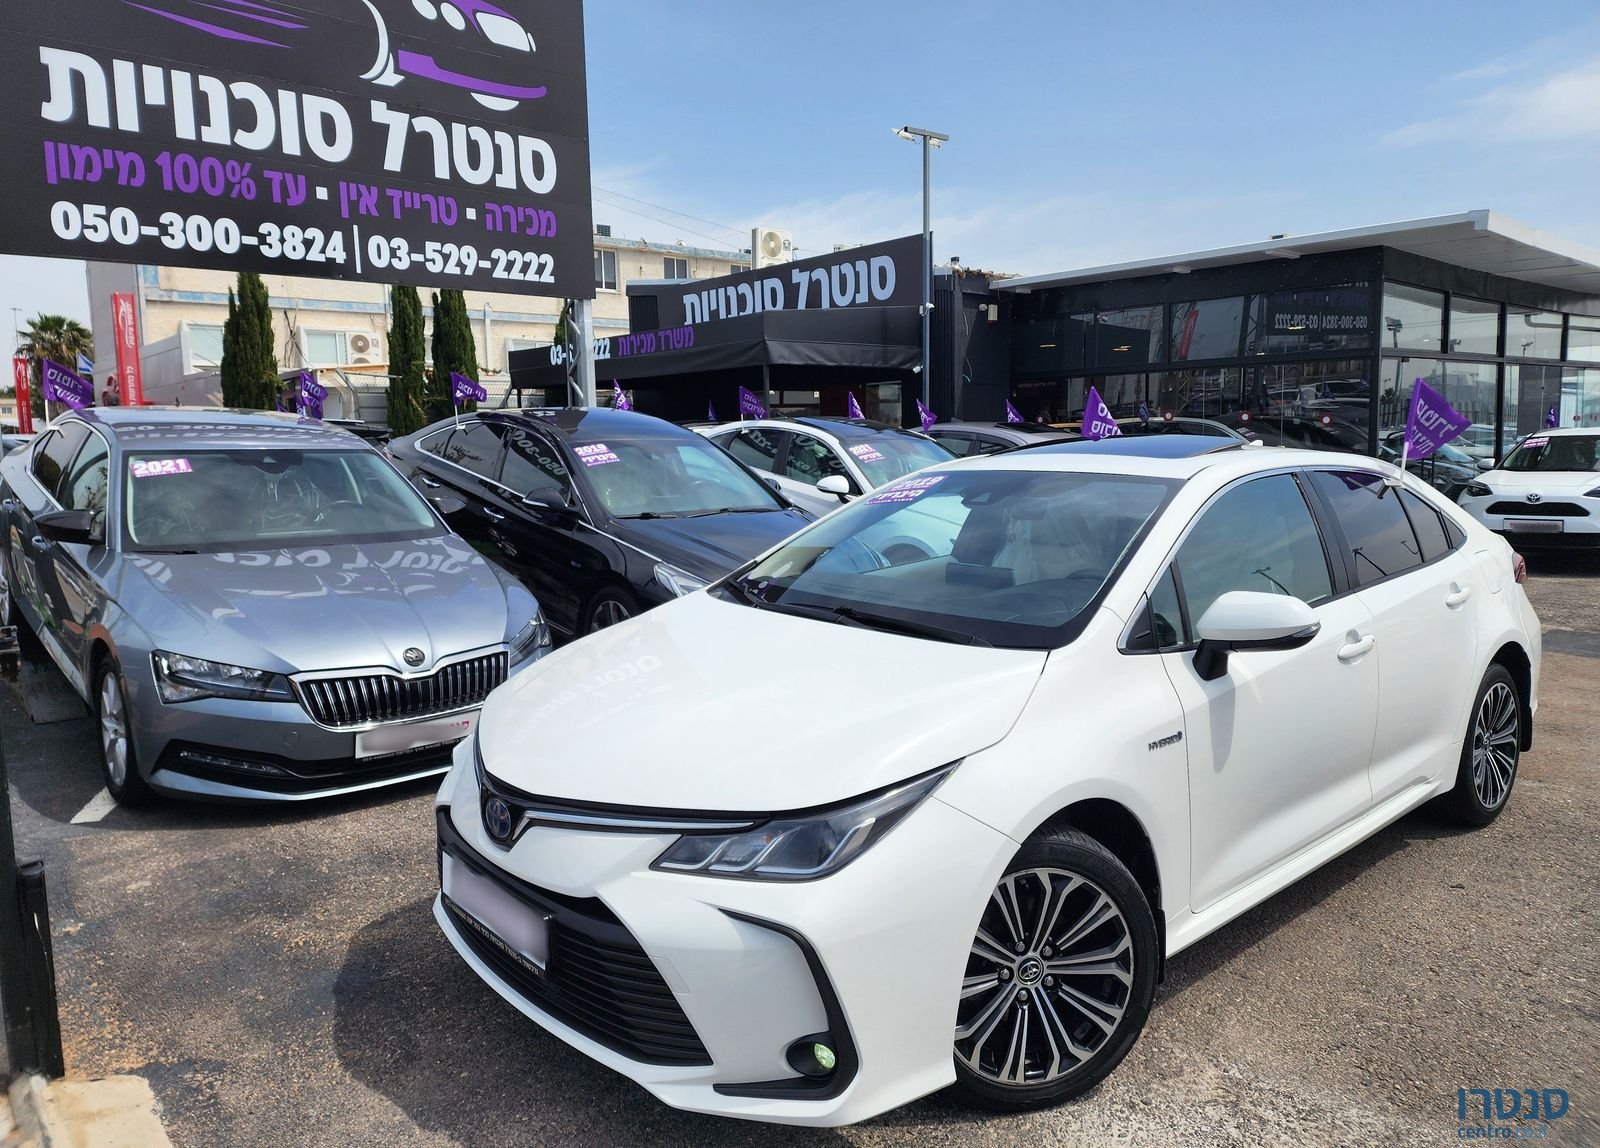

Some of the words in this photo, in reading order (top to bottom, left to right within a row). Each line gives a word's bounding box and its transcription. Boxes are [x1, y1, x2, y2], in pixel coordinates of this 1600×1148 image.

[39, 46, 354, 163] סוכנויות
[43, 141, 146, 188] מימון
[370, 99, 558, 195] סנטרל
[155, 151, 256, 200] 100%
[263, 169, 307, 206] עד
[338, 179, 379, 217] אין
[390, 189, 458, 226] טרייד
[485, 201, 557, 239] מכירה
[50, 200, 347, 264] 050-300-3824
[368, 241, 556, 284] 03-529-2222
[683, 277, 785, 326] סוכנויות
[791, 255, 896, 310] סנטרל
[617, 331, 657, 357] מכירות
[658, 326, 695, 351] משרד
[133, 458, 188, 475] 2021
